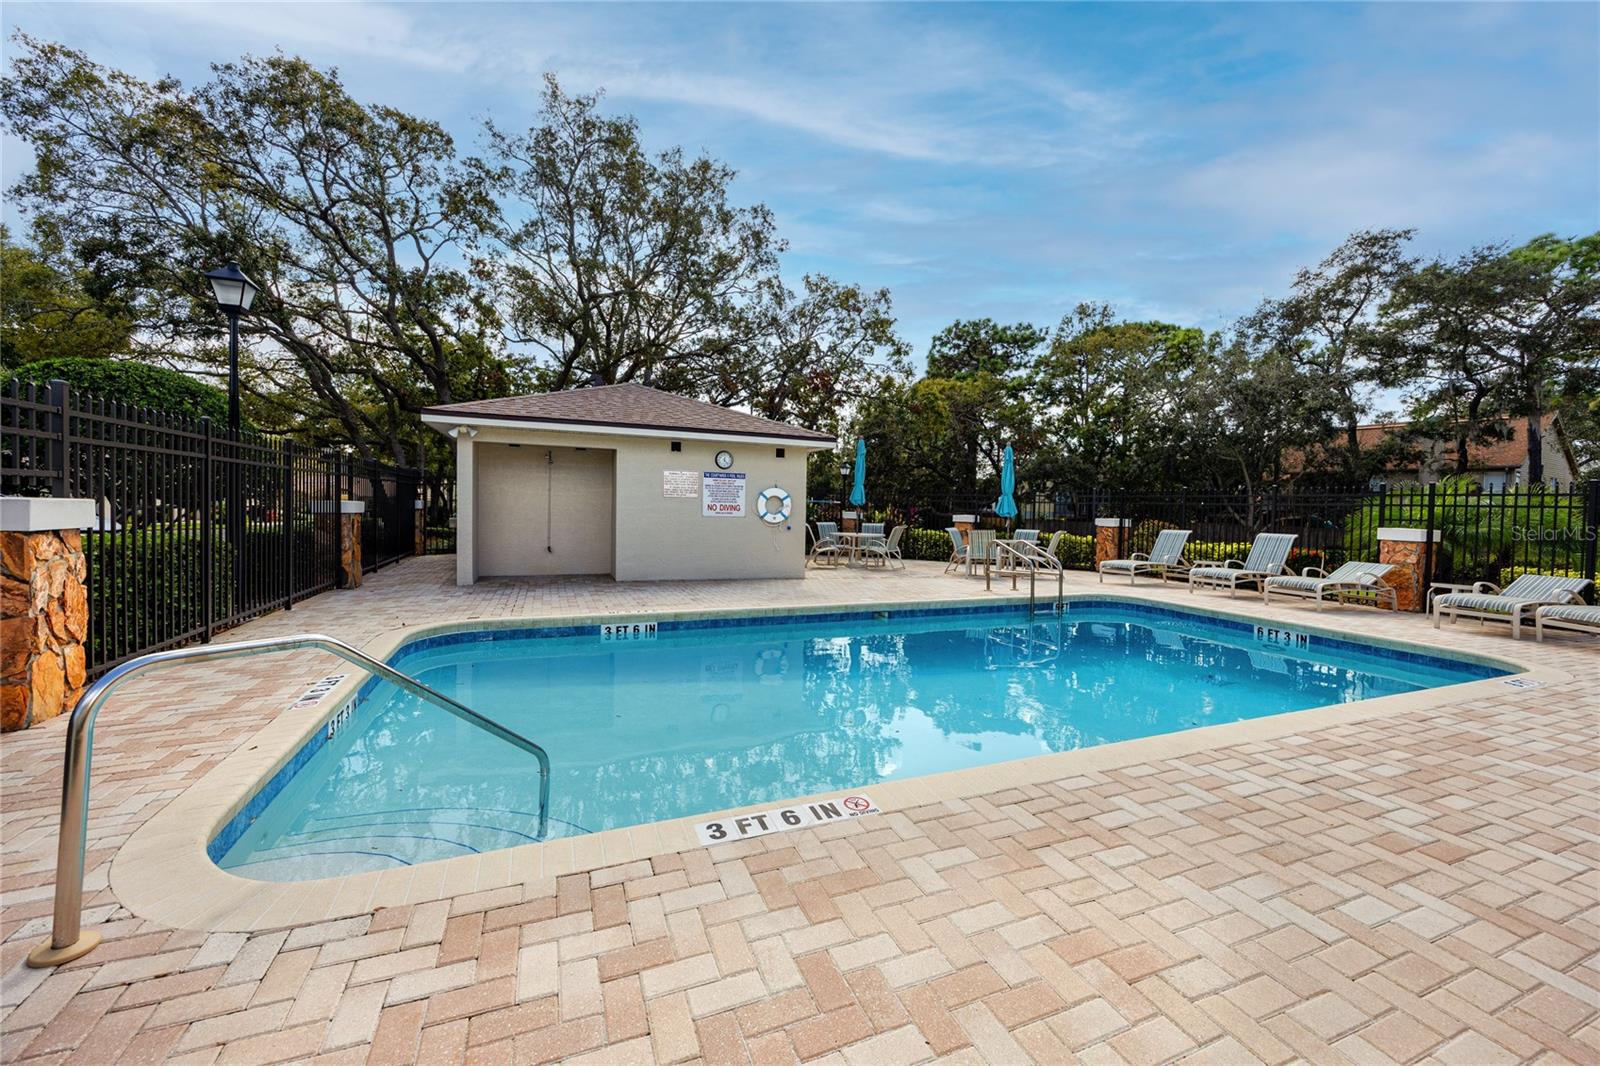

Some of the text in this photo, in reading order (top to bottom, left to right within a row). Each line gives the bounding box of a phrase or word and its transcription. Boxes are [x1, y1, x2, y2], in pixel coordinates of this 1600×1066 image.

[604, 624, 656, 635] 3 FT 6 IN
[1257, 626, 1307, 643] 6 FT 3 IN
[706, 802, 842, 840] 3 FT 6 IN
